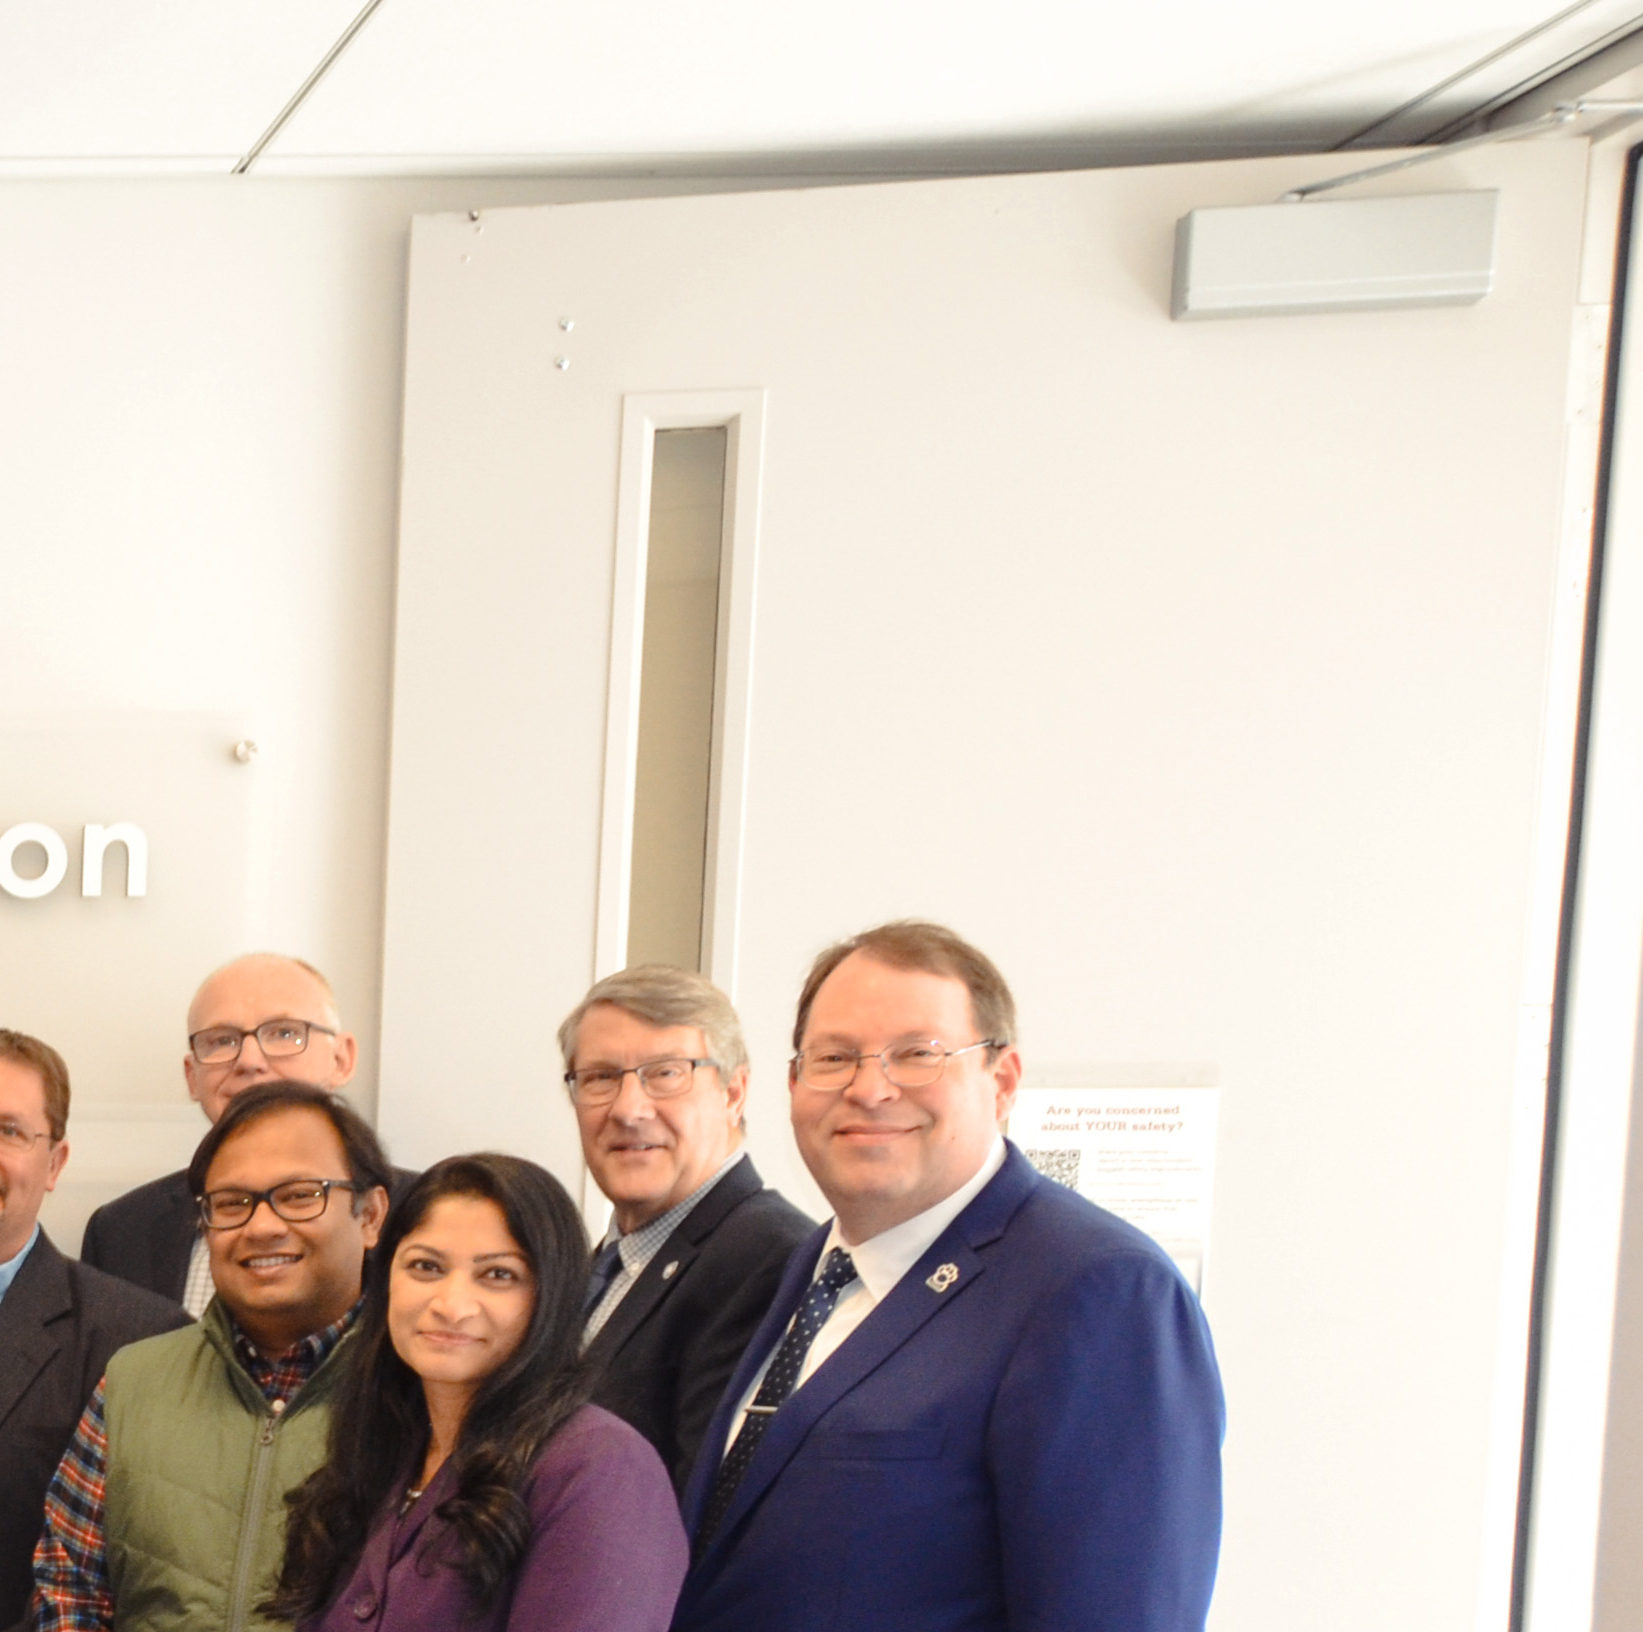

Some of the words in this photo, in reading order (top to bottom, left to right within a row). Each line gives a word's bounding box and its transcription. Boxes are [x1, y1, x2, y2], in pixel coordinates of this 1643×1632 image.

[1045, 1105, 1072, 1116] Are
[1076, 1106, 1102, 1118] you
[1105, 1103, 1181, 1116] concerned
[1040, 1121, 1081, 1132] about
[1085, 1120, 1128, 1132] YOUR
[1131, 1120, 1185, 1134] safety?
